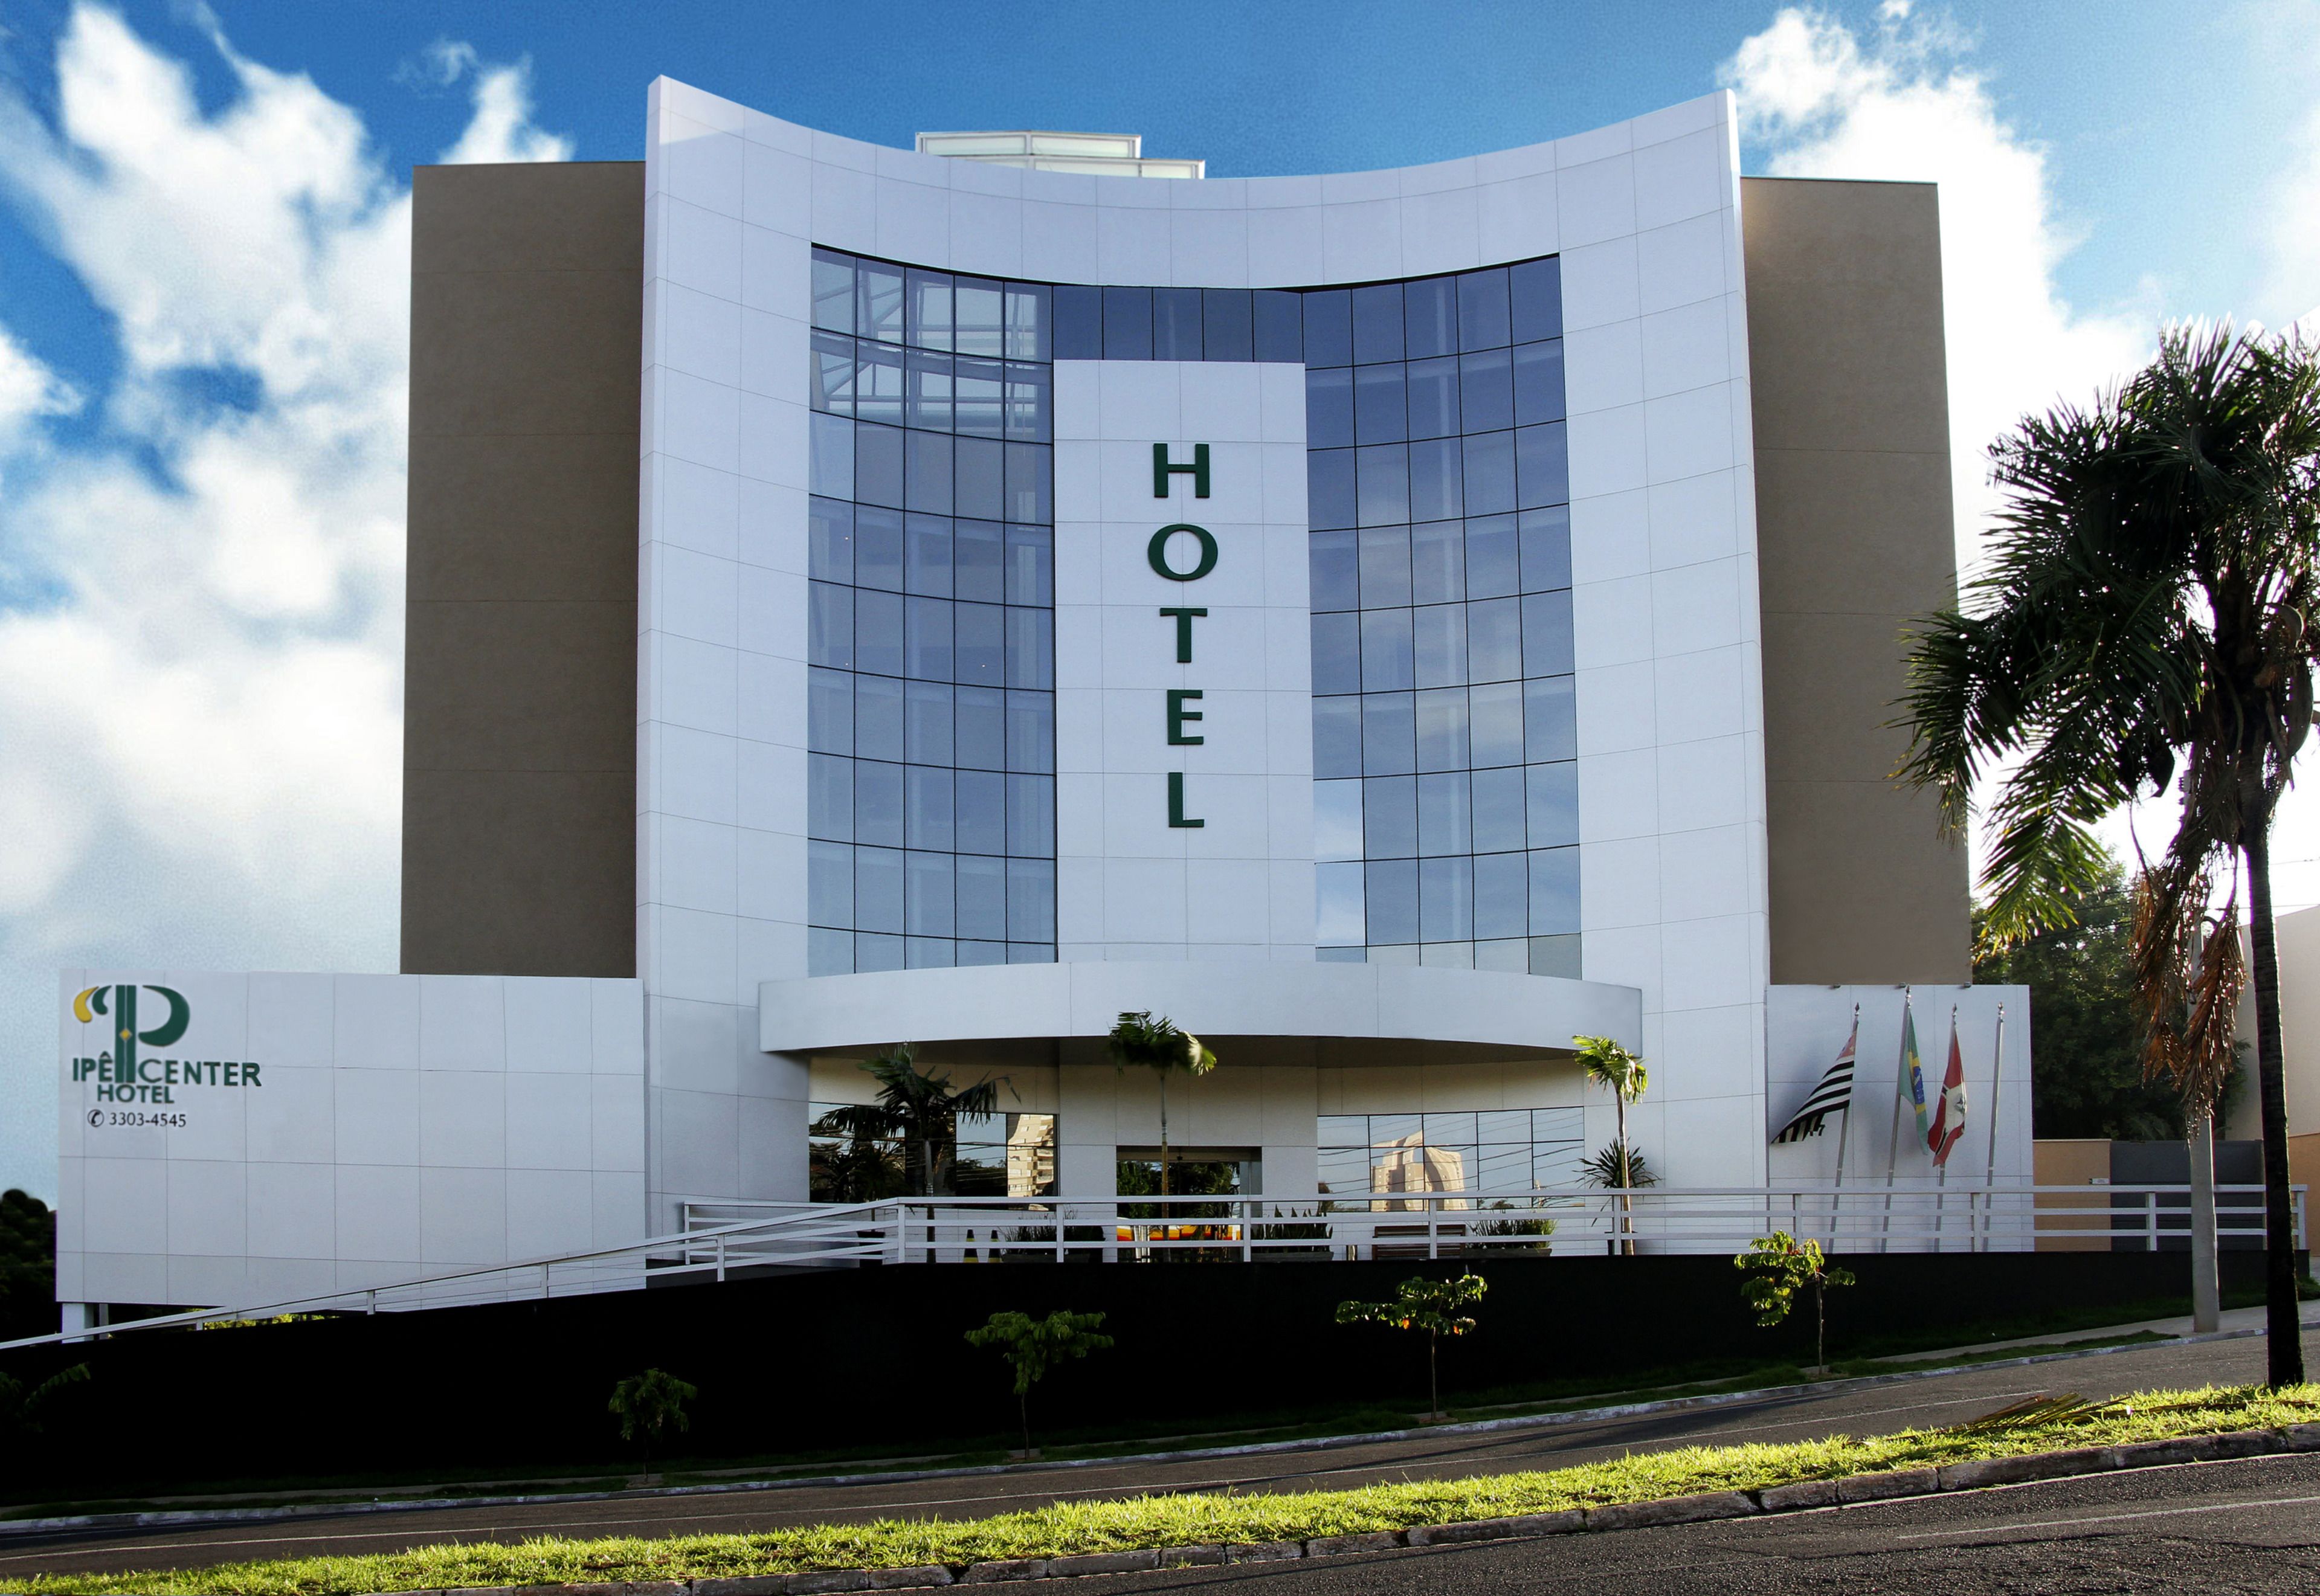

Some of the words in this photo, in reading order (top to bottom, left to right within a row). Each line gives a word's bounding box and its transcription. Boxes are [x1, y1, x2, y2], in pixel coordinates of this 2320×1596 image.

[1147, 443, 1219, 828] HOTEL
[72, 1051, 114, 1083] IPÊ
[137, 1058, 262, 1087] CENTER
[97, 1084, 175, 1104] HOTEL
[108, 1112, 187, 1128] 3303-4545
